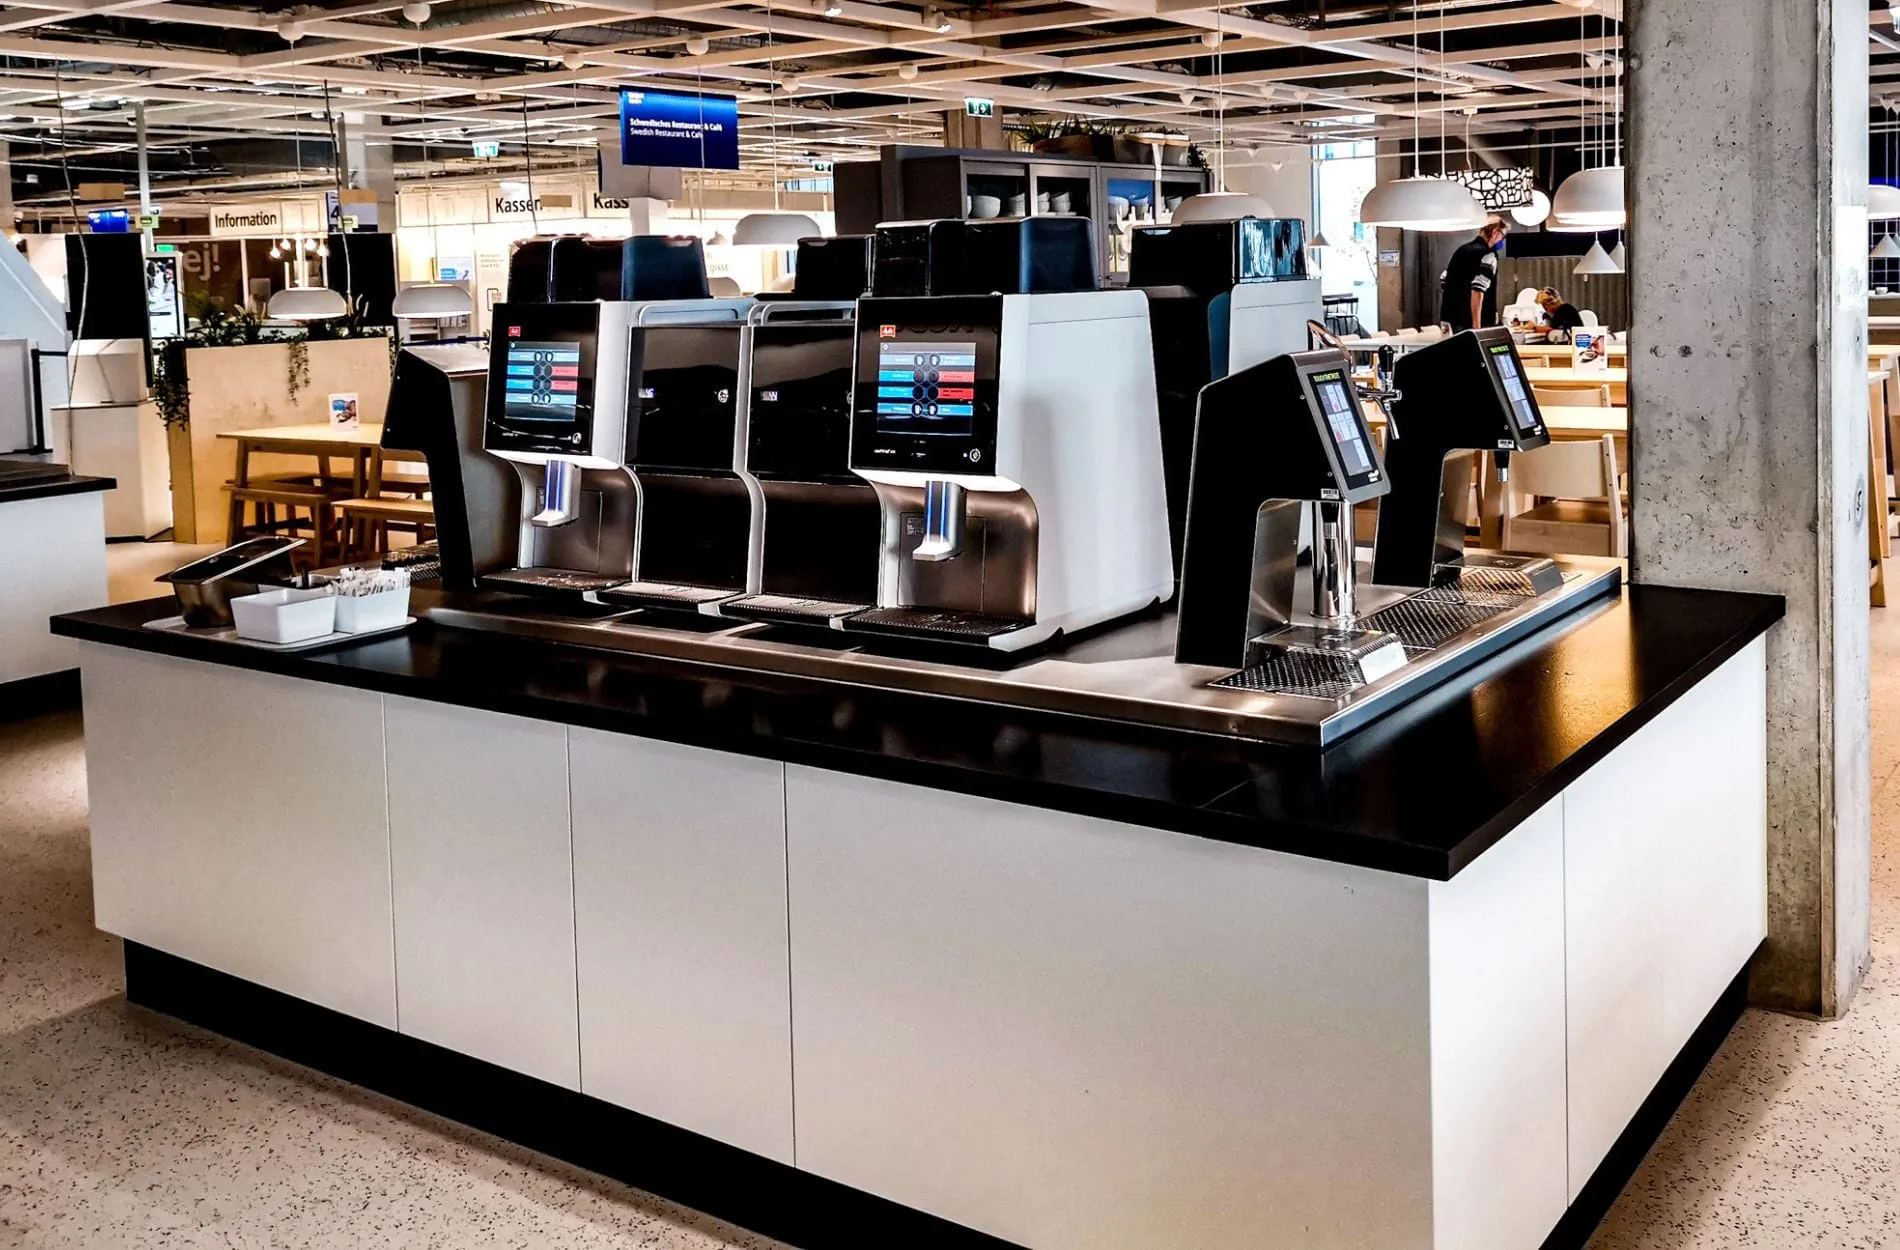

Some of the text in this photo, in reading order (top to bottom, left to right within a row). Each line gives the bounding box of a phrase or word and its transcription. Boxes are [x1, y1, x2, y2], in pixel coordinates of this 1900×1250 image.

[630, 127, 655, 136] Swedish
[655, 129, 685, 138] Restaurant
[685, 130, 691, 138] &
[215, 211, 277, 228] Information
